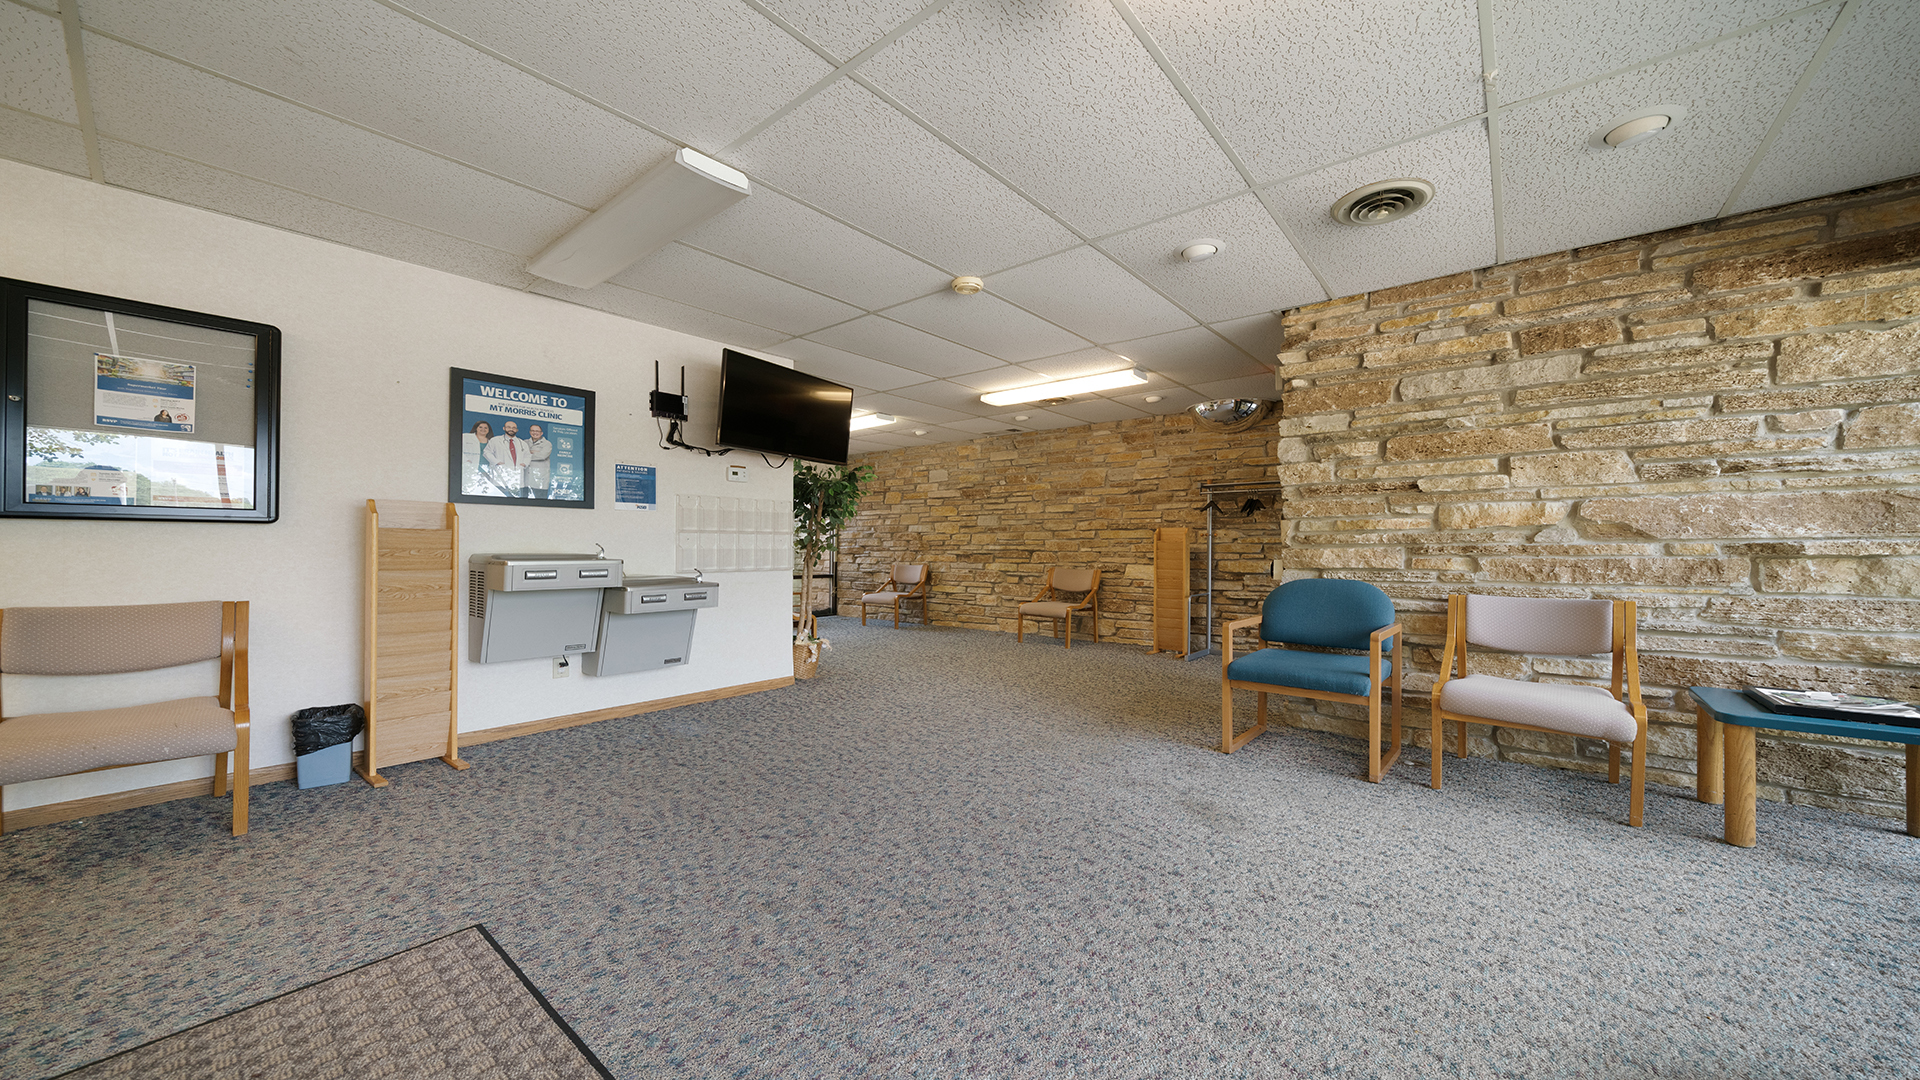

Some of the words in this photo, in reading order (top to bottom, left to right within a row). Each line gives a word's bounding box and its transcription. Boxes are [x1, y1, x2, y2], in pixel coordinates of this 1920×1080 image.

[480, 385, 548, 405] WELCOME
[551, 396, 568, 408] TO
[489, 404, 503, 412] MT
[504, 406, 537, 417] MORRIS
[538, 411, 563, 421] CLINIC
